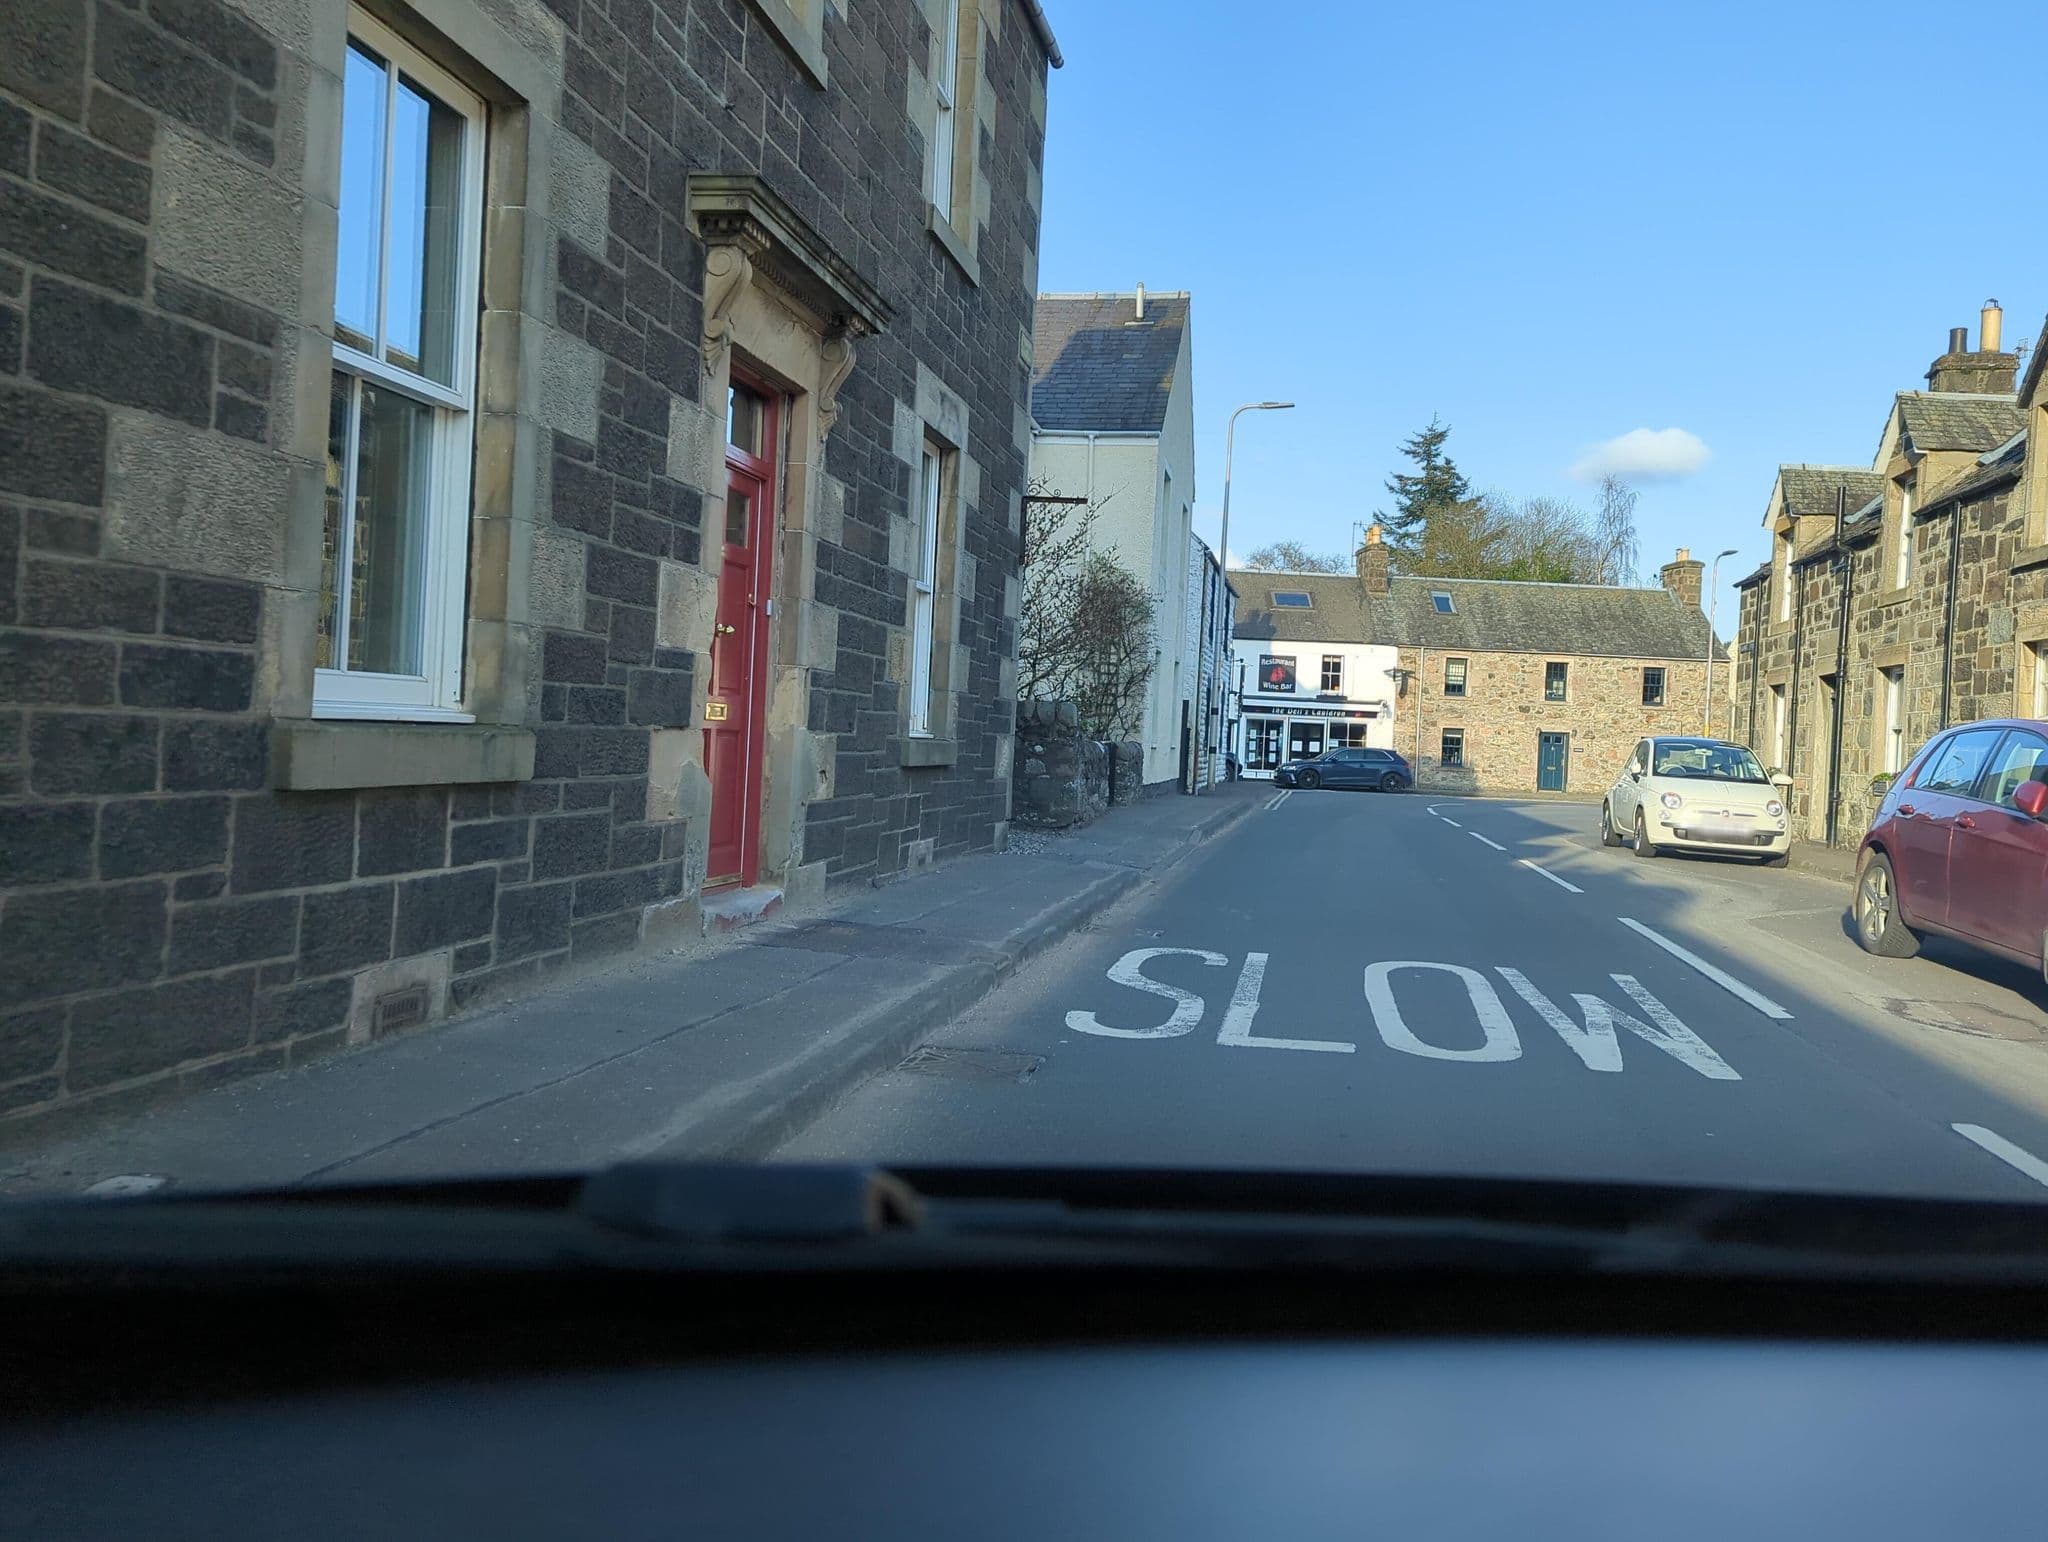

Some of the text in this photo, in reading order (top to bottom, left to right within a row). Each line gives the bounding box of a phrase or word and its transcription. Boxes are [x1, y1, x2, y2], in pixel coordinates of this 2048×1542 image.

[1261, 658, 1295, 667] Restaurant
[1263, 681, 1279, 690] Wine
[1065, 947, 1742, 1081] SLOW
